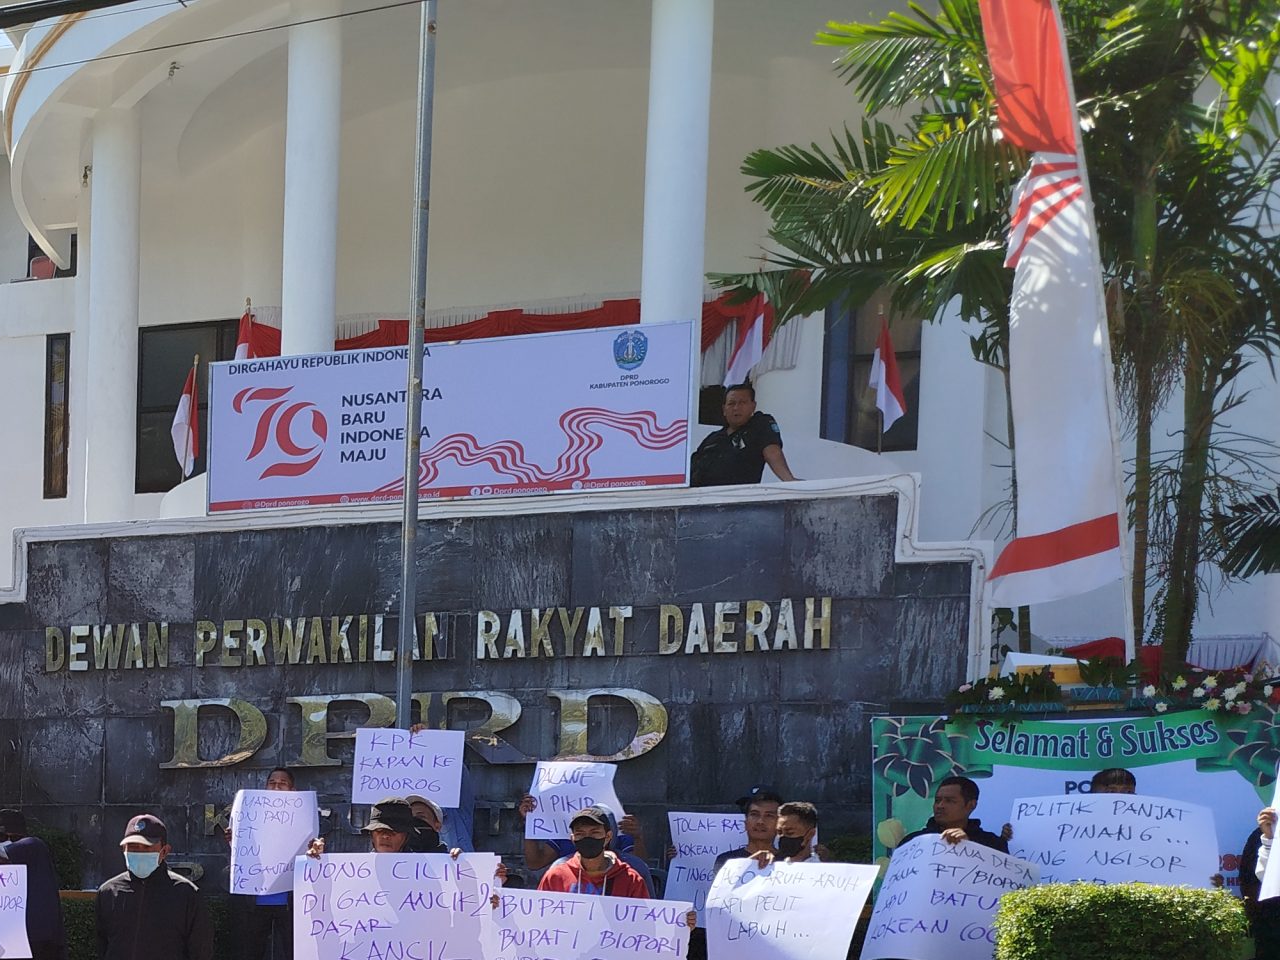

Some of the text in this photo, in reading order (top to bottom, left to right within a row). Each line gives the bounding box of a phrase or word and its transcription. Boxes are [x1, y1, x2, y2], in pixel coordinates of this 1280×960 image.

[228, 346, 432, 375] DIRGAHAYU REPUBLIK INDONEA
[589, 378, 670, 389] KABUPATEN PONOROGO
[341, 387, 443, 408] NUSANTRA
[341, 411, 386, 426] BARU
[340, 426, 431, 445] INDONEA
[340, 447, 387, 463] MAJU
[45, 620, 170, 673] DEWAN
[476, 605, 633, 660] RAKYAT
[659, 596, 832, 655] DAERAH
[158, 687, 669, 769] DPRD
[973, 718, 1220, 759] Selamat & Sukses
[370, 732, 428, 751] KPK
[360, 754, 458, 770] KAPAN KE
[1017, 799, 1192, 822] POLITIK PANJAT
[673, 816, 717, 835] TOLAK
[931, 841, 985, 862] DANA
[302, 860, 479, 884] WONG CILIK
[754, 895, 806, 913] PELIT
[930, 888, 999, 911] BATU
[500, 894, 688, 928] BUPATI UTANG
[310, 919, 393, 937] DASAR
[498, 928, 682, 957] BUPATI BIOPORI
